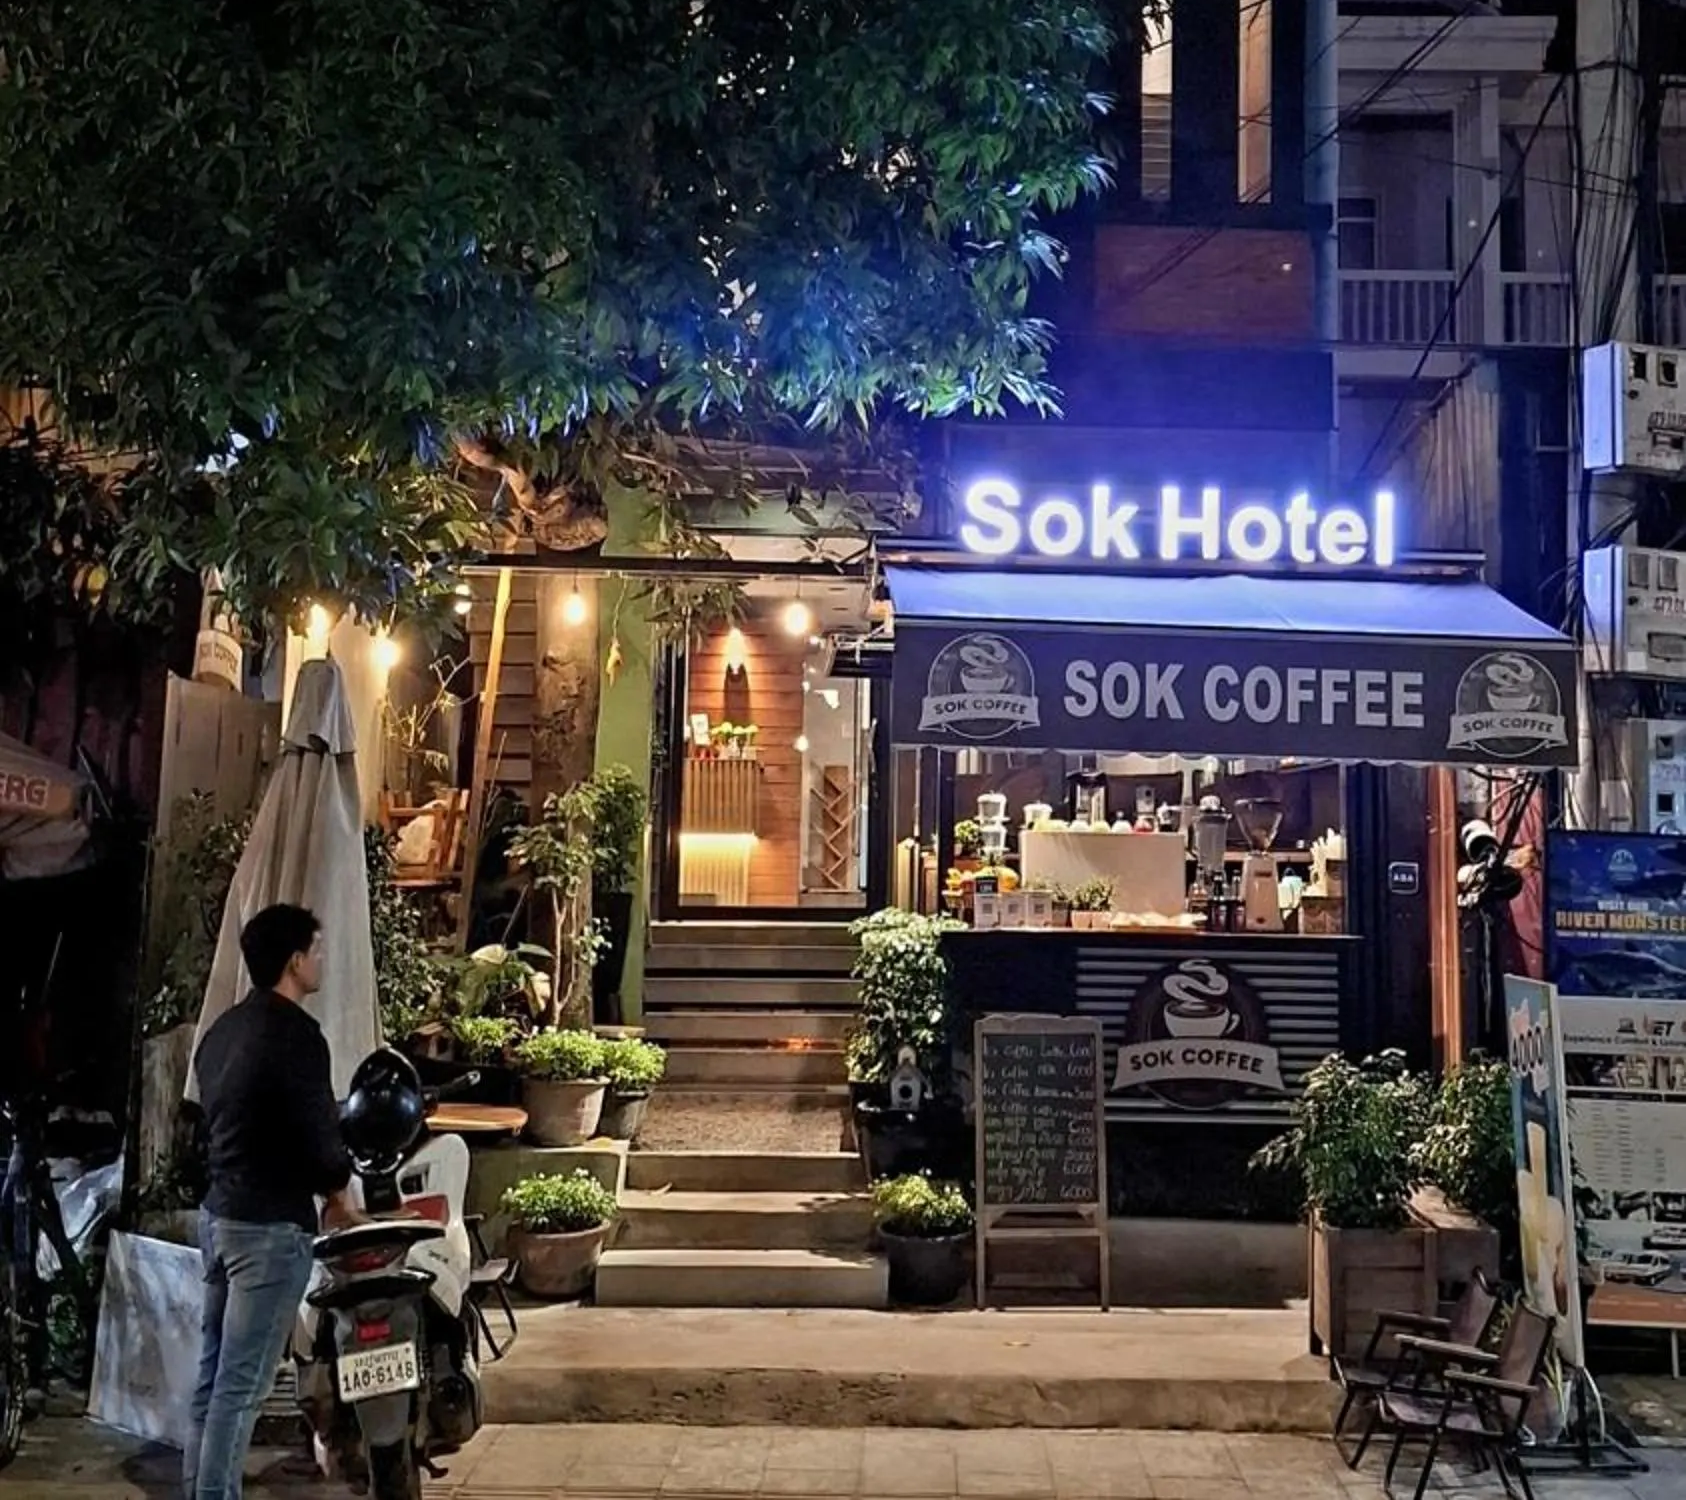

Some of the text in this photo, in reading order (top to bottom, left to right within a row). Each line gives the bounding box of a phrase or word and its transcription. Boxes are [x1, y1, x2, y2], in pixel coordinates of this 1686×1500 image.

[960, 479, 1395, 567] Sok Hotel
[1064, 659, 1424, 728] SOK COFFEE
[934, 699, 1027, 715] SOK COFFEE
[1462, 719, 1554, 734] SOK COFFEE
[1555, 911, 1606, 930] RIVER
[1130, 1049, 1264, 1074] SOK COFFEE
